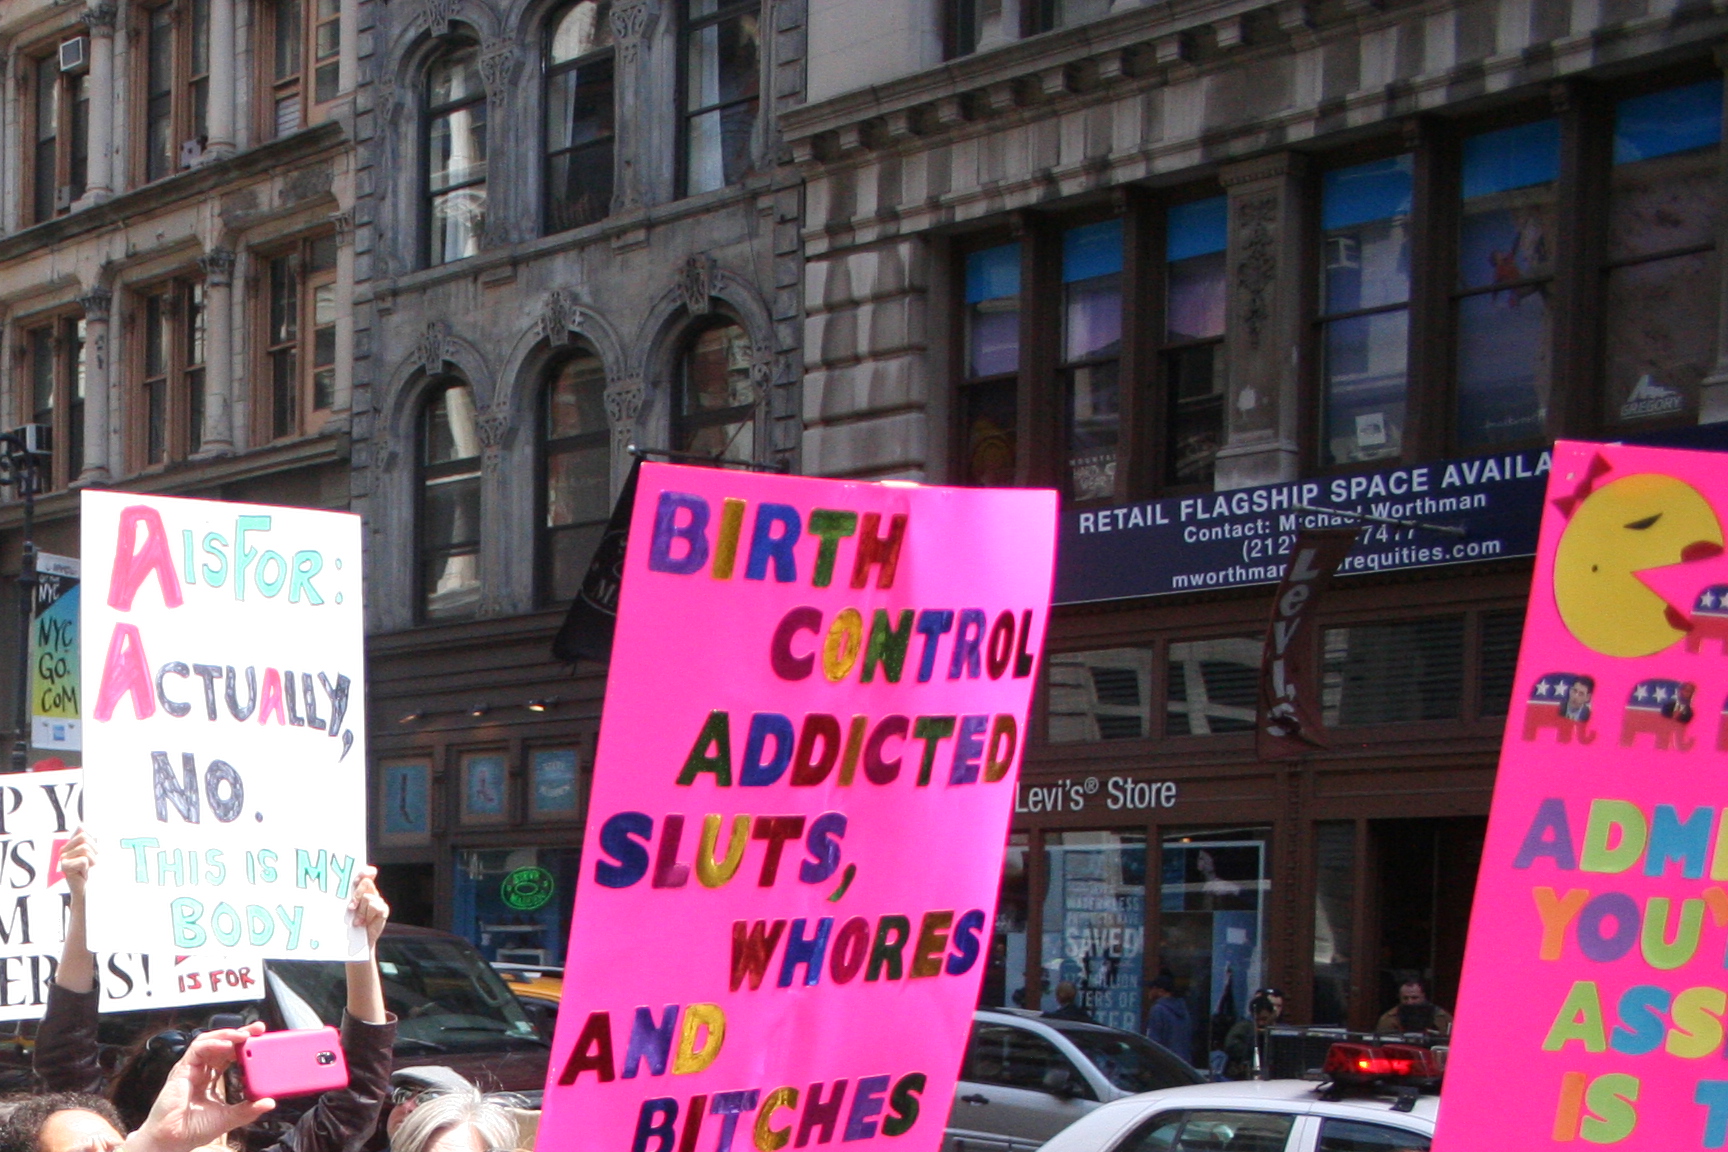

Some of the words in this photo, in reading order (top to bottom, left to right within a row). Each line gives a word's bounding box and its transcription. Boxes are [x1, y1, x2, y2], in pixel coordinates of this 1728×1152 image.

[1079, 503, 1170, 535] RETAIL
[1179, 484, 1319, 522] FLAGSHIP
[1330, 468, 1430, 503] SPACE
[1183, 518, 1271, 544] Contact:
[1371, 493, 1487, 520] Worthman
[648, 490, 908, 590] BIRTH
[39, 617, 73, 652] NYC
[771, 607, 1036, 683] CONTROL
[94, 623, 354, 764] ACTUALLY,
[677, 711, 1017, 787] ADDICTED
[150, 750, 265, 824] NO.
[1106, 778, 1178, 812] Store
[119, 836, 226, 888] THIS
[245, 847, 278, 884] IS
[296, 847, 355, 898] MY
[594, 812, 857, 903] SLUTS,
[171, 897, 320, 951] BODY.
[729, 910, 985, 992] WHORES
[1065, 926, 1141, 958] SAVED
[178, 972, 202, 993] IS
[209, 967, 256, 993] FOR
[558, 1003, 727, 1086] AND
[1552, 1072, 1640, 1145] IS
